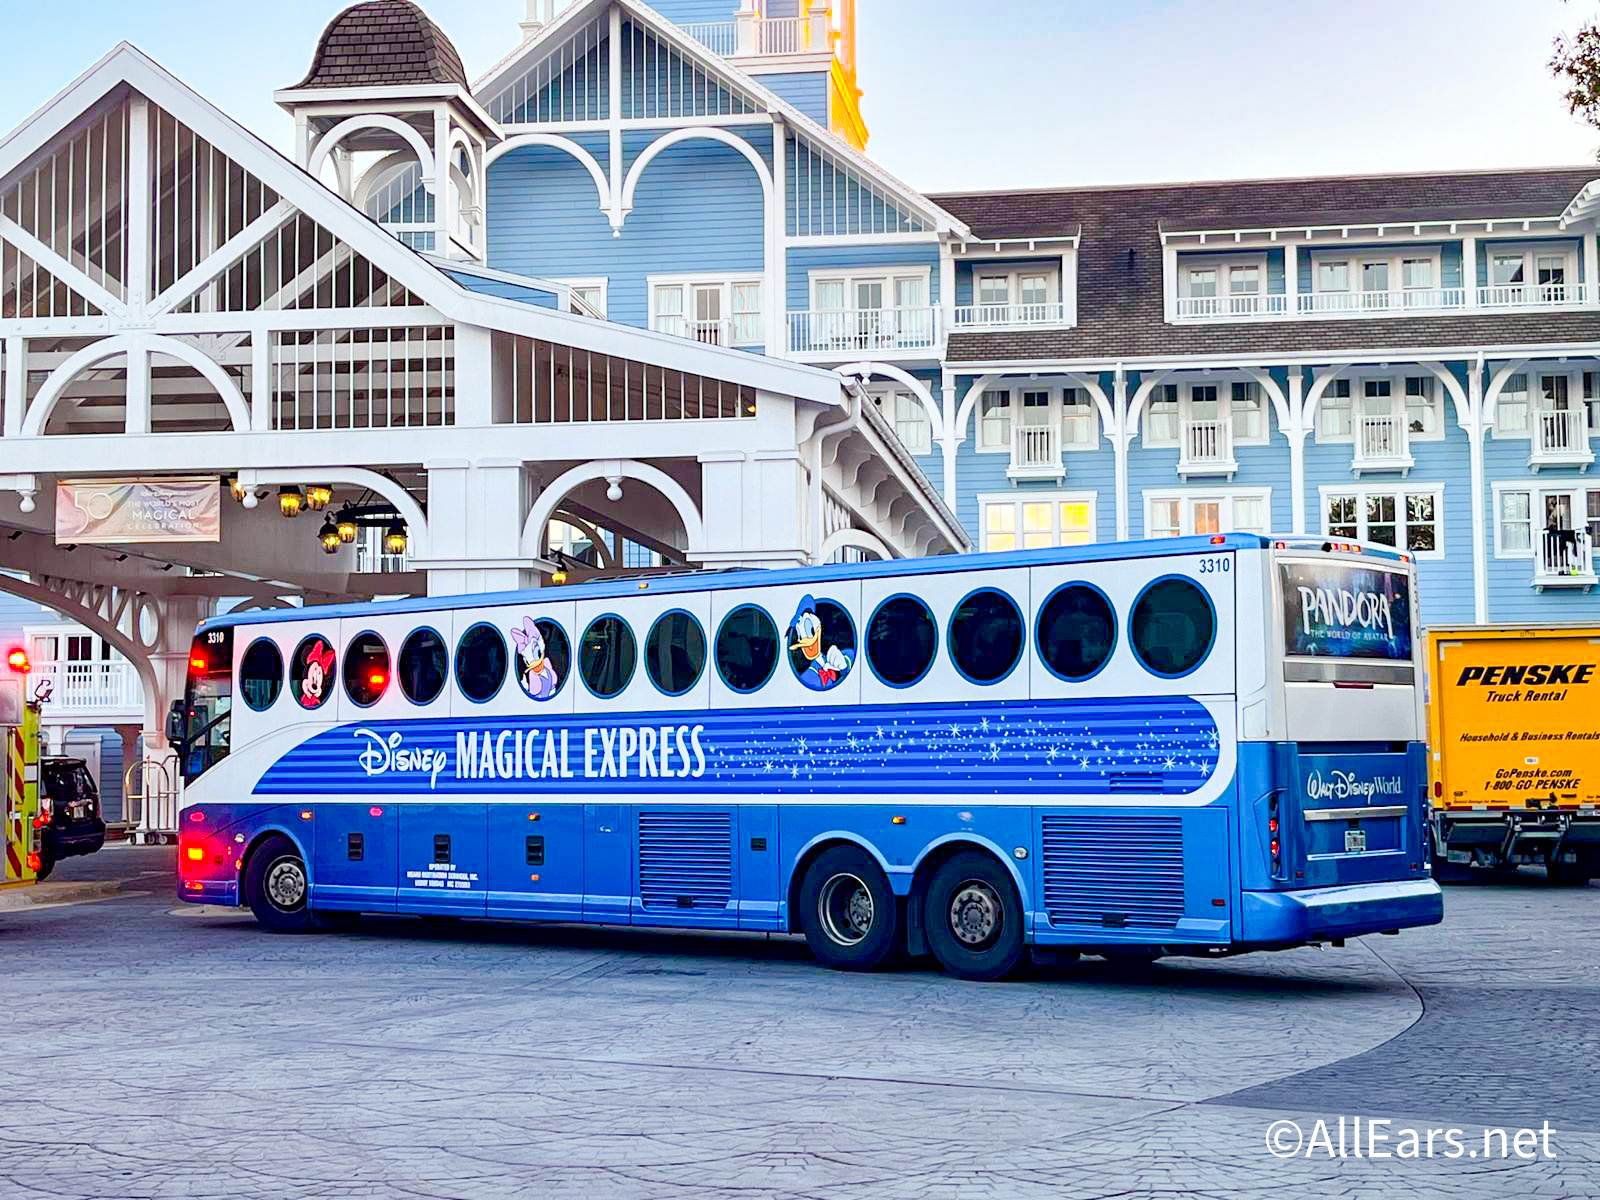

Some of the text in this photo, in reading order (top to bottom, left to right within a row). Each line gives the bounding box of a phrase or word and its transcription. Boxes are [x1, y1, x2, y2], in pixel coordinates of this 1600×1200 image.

[132, 510, 196, 521] MAGICAL
[127, 522, 201, 530] CELEBRATION
[1199, 557, 1230, 573] 3310
[1297, 586, 1393, 639] PANDORA
[207, 632, 225, 644] 3310
[1311, 630, 1325, 639] THE
[1327, 630, 1350, 640] WORLD
[1456, 664, 1597, 686] PENSKE
[1486, 689, 1568, 703] Truck Rental
[1460, 731, 1600, 742] Household & Business Rentals
[456, 729, 574, 779] MAGICAL
[584, 725, 706, 778] EXPRESS
[1495, 768, 1572, 779] GoPenske.com
[1374, 776, 1401, 794] World
[1484, 778, 1581, 791] 1-800-GO-PENSKE
